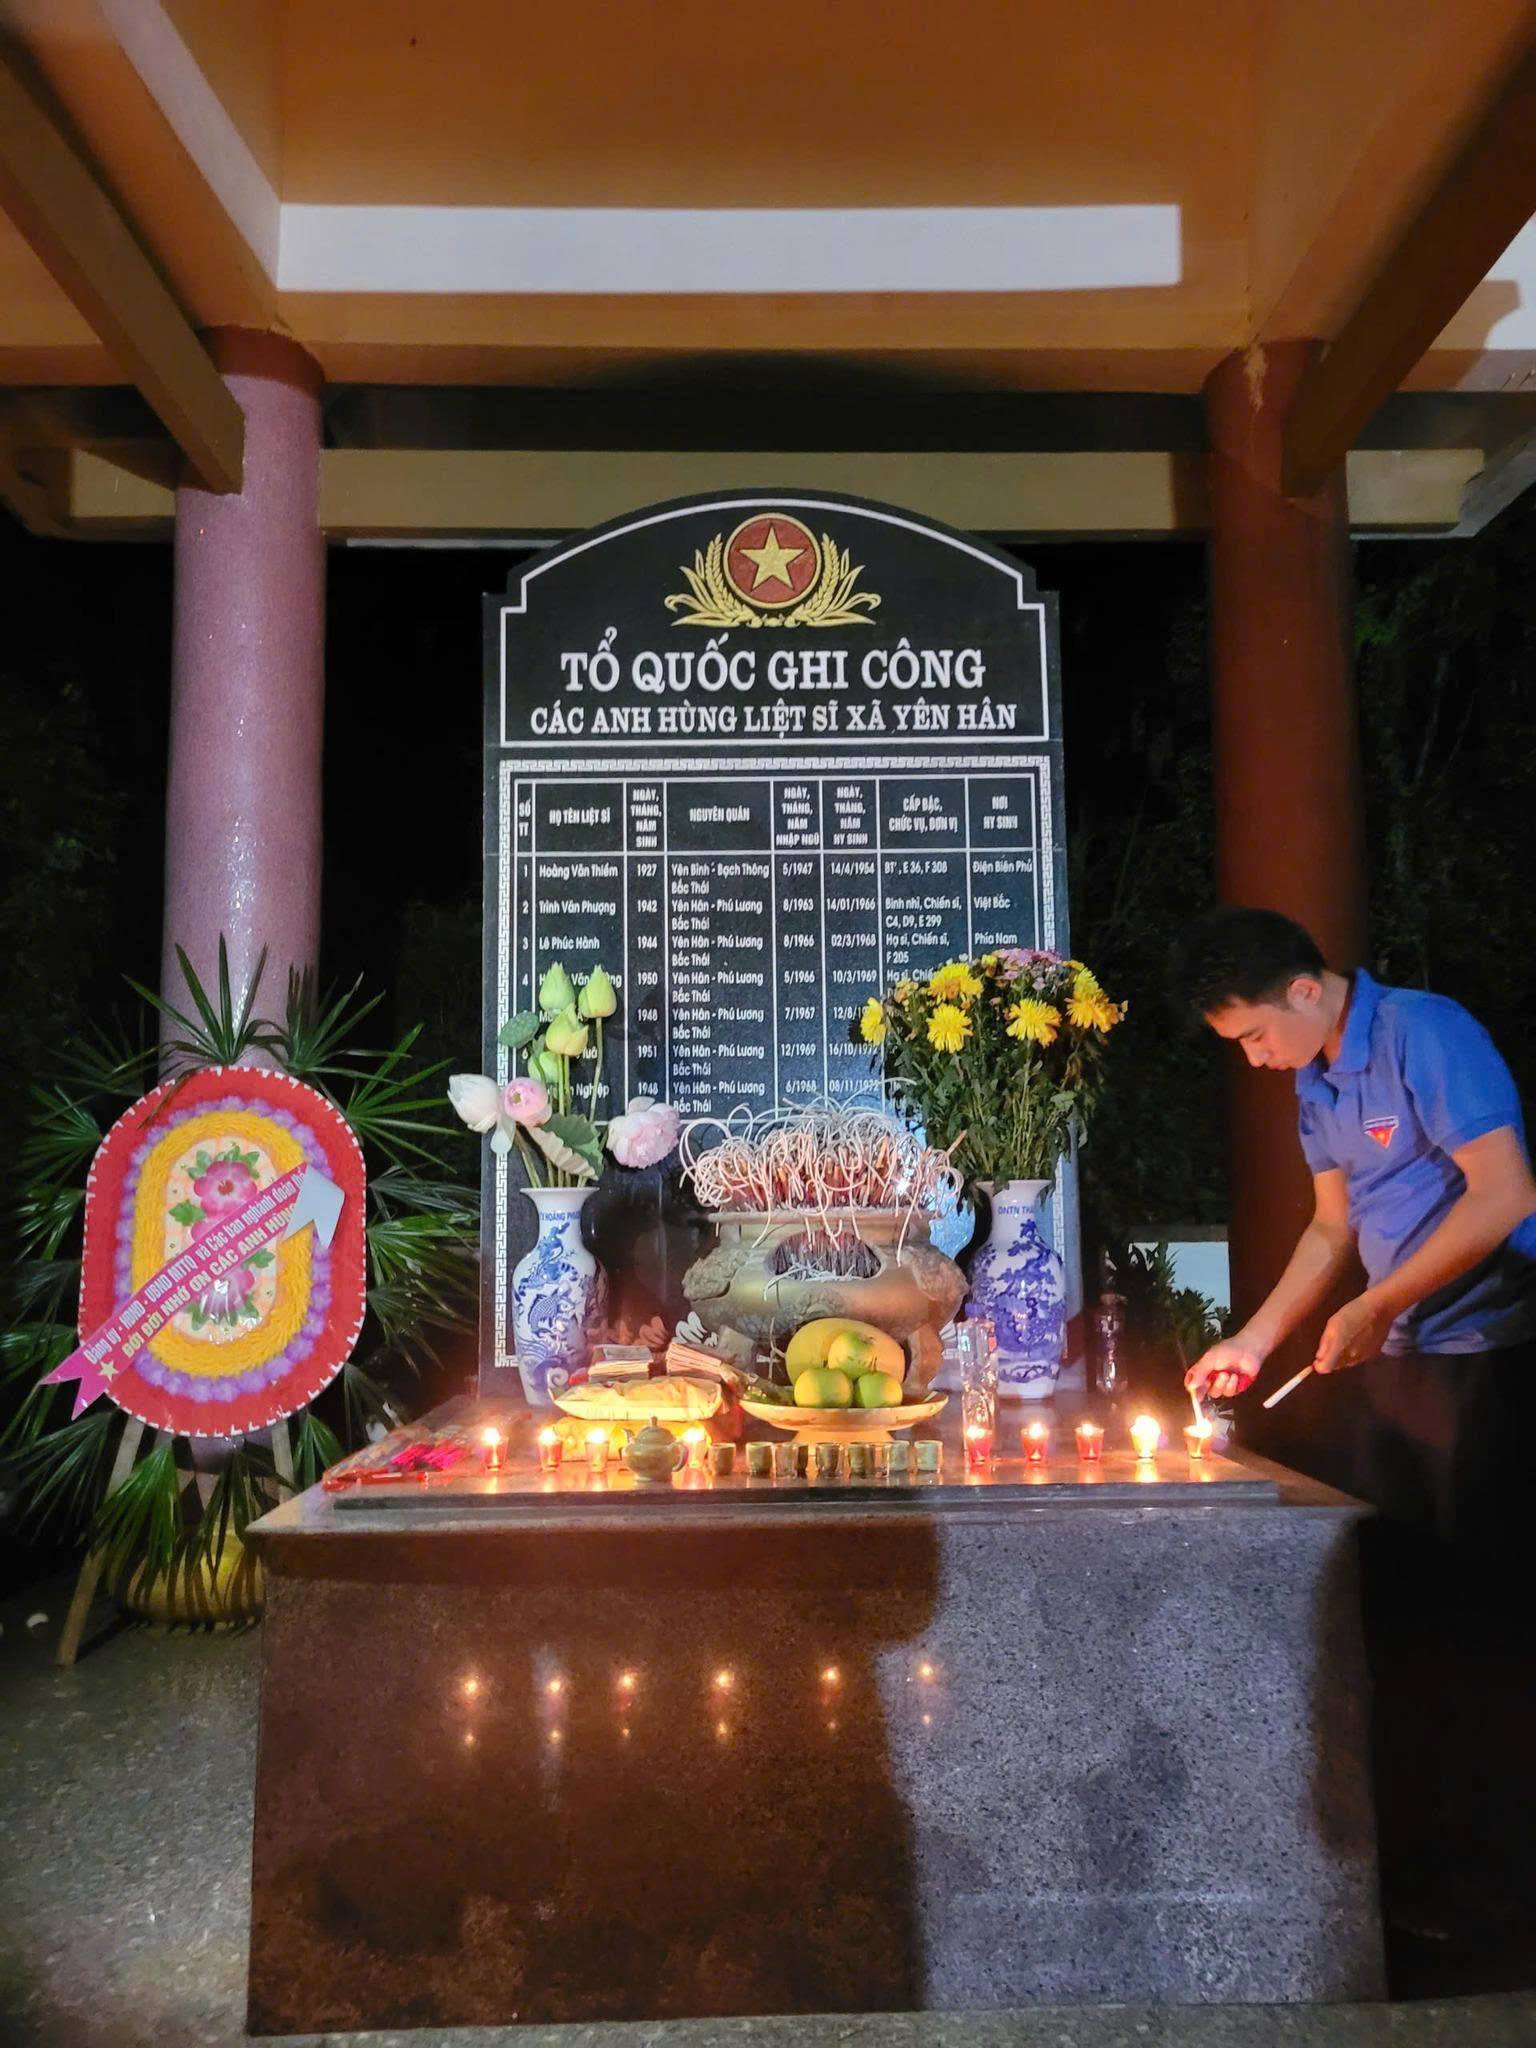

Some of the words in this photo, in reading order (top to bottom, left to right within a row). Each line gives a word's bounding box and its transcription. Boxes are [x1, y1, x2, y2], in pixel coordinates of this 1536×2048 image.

[561, 626, 620, 692] TỔ
[632, 632, 756, 694] QUỐC
[768, 649, 849, 691] GHI
[861, 637, 987, 689] CÔNG
[531, 699, 584, 734] CÁC
[591, 706, 652, 734] ANH
[658, 699, 738, 734] HÙNG
[744, 697, 807, 739] LIỆT
[812, 699, 839, 732] SĨ
[846, 699, 887, 731] XÃ
[892, 695, 950, 731] YÊN
[957, 695, 1017, 731] HÂN
[519, 798, 531, 817] SỐ
[689, 805, 724, 822] NGUYÊN
[725, 805, 750, 823] QUÁN
[549, 808, 562, 827] HỌ
[563, 806, 580, 824] TÊN
[581, 806, 600, 827] LIỆT
[519, 822, 529, 837] TT
[523, 864, 528, 878] 1
[540, 863, 570, 880] Hoàng
[637, 863, 657, 877] 1927
[671, 863, 689, 877] Yên
[717, 863, 741, 879] Bạch
[742, 863, 770, 879] Thông
[523, 900, 529, 914] 2
[637, 899, 658, 913] 1942
[671, 899, 689, 912] Yên
[717, 898, 734, 912] Phú
[735, 899, 763, 915] Lương
[783, 898, 814, 913] 8/1963
[826, 897, 876, 912] 14/01/1966
[923, 896, 950, 910] Chiến
[925, 914, 942, 928] 299
[523, 935, 529, 949] 3
[539, 936, 551, 950] Lê
[551, 935, 574, 950] Phúc
[637, 936, 658, 949] 1944
[672, 935, 689, 949] Yên
[717, 934, 734, 948] Phú
[735, 935, 763, 951] Lương
[783, 934, 815, 949] 8/1966
[831, 933, 877, 948] 02/3/1968
[911, 932, 938, 946] Chiến
[974, 931, 995, 945] Phía
[995, 933, 1017, 945] Nam
[893, 951, 909, 964] 205
[522, 973, 529, 986] 4
[637, 972, 658, 985] 1950
[672, 972, 690, 985] Yên
[717, 971, 735, 985] Phú
[736, 971, 764, 987] Lương
[832, 970, 877, 984] 10/3/1969
[637, 1008, 658, 1021] 1948
[672, 1008, 690, 1021] Yên
[718, 1007, 735, 1021] Phú
[736, 1008, 764, 1023] Lương
[784, 1006, 815, 1021] 7/1967
[522, 1047, 528, 1060] 6
[638, 1045, 657, 1058] 1951
[718, 1044, 736, 1057] Phú
[737, 1045, 765, 1060] Lương
[781, 1043, 816, 1058] 12/1969
[719, 1080, 736, 1095] Phú
[737, 1081, 765, 1097] Lương
[209, 1249, 239, 1275] CÁC
[237, 1227, 268, 1255] ANH
